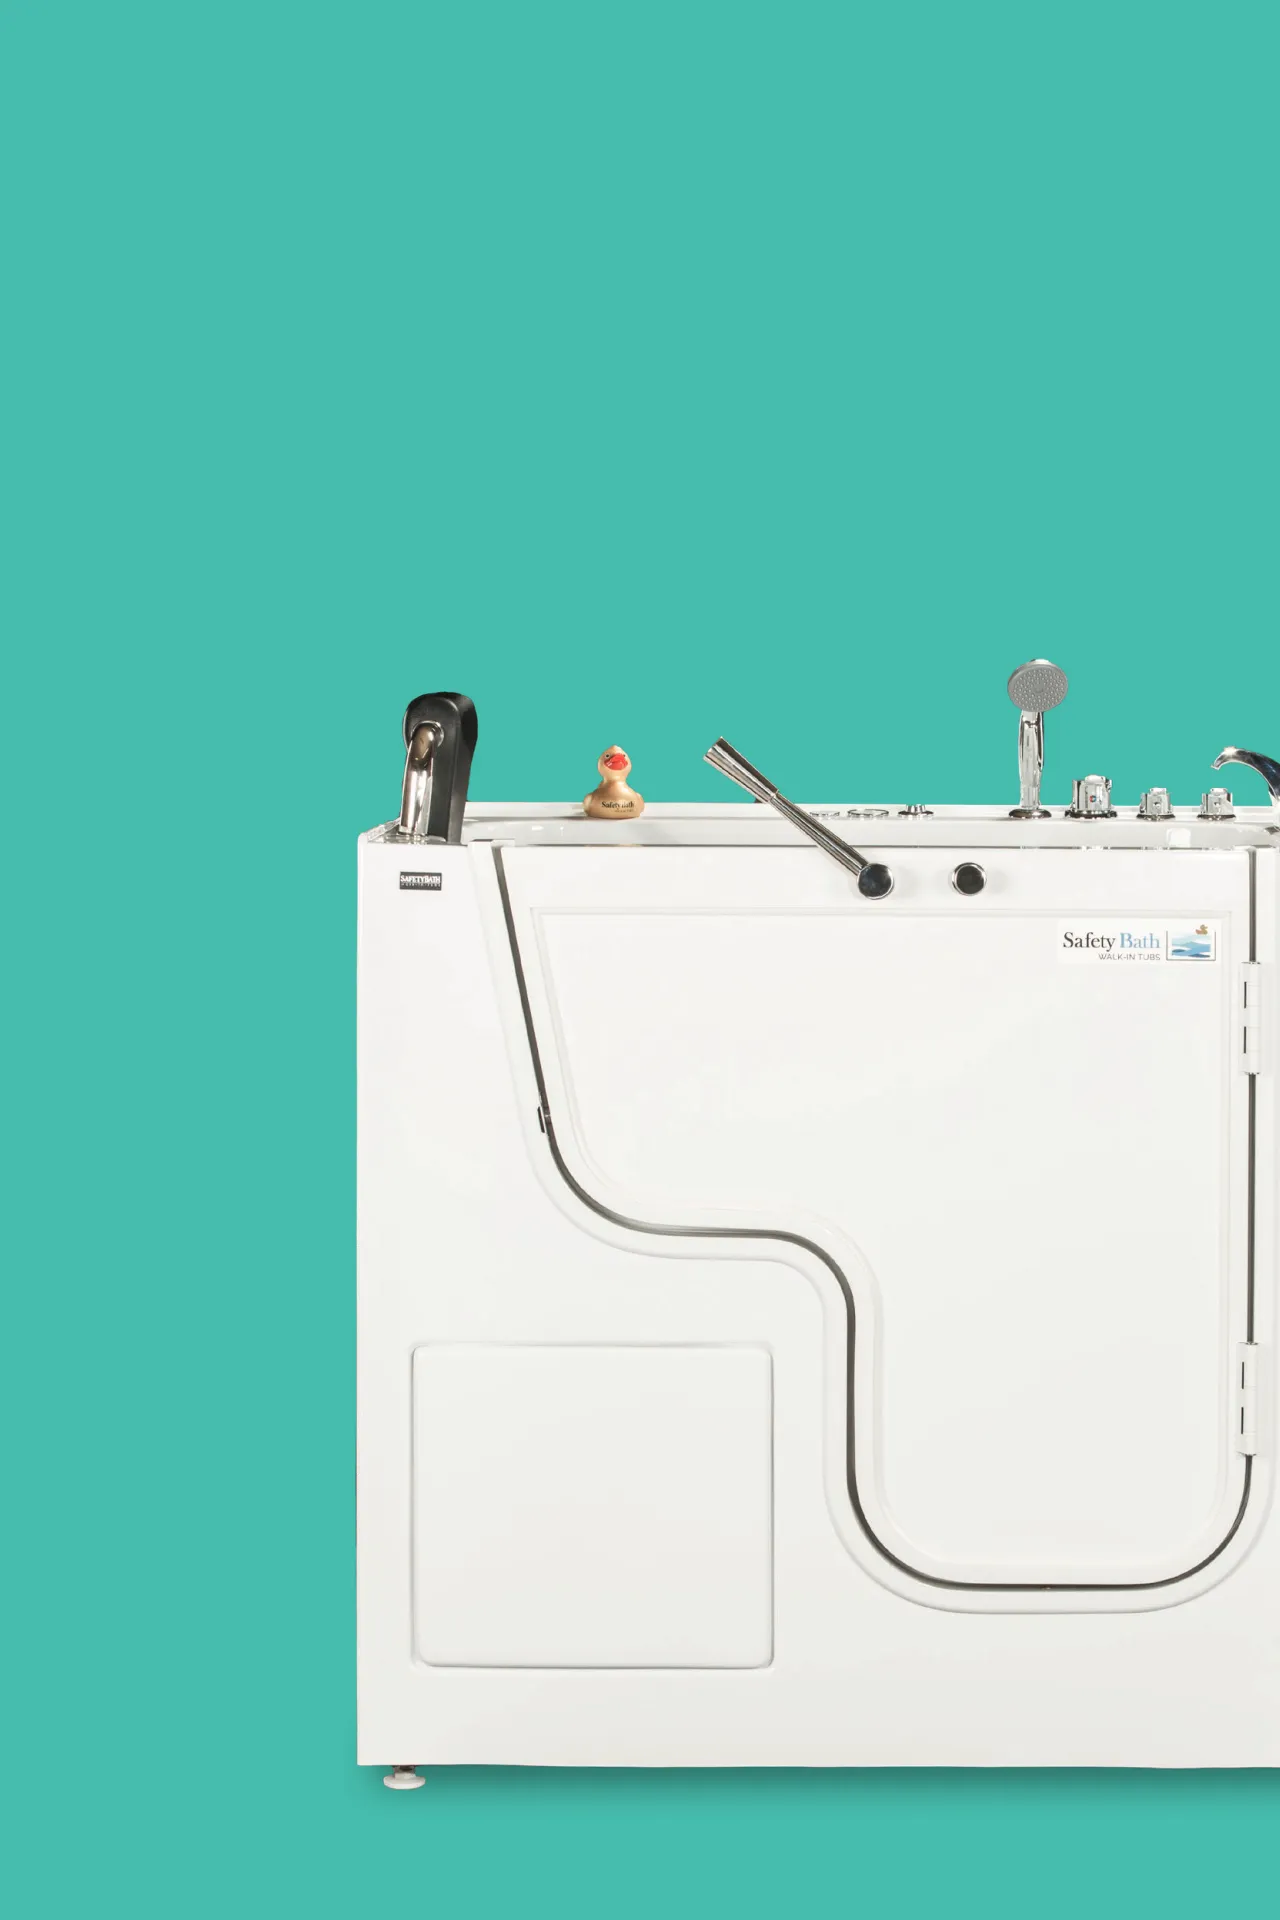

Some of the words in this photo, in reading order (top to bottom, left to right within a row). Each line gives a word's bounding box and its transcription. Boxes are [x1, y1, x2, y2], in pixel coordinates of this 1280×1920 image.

[601, 801, 620, 810] Safety
[1063, 931, 1116, 952] Safety
[1120, 932, 1160, 949] Bath
[1098, 953, 1136, 961] WALK-IN
[1139, 953, 1161, 961] TUBS
